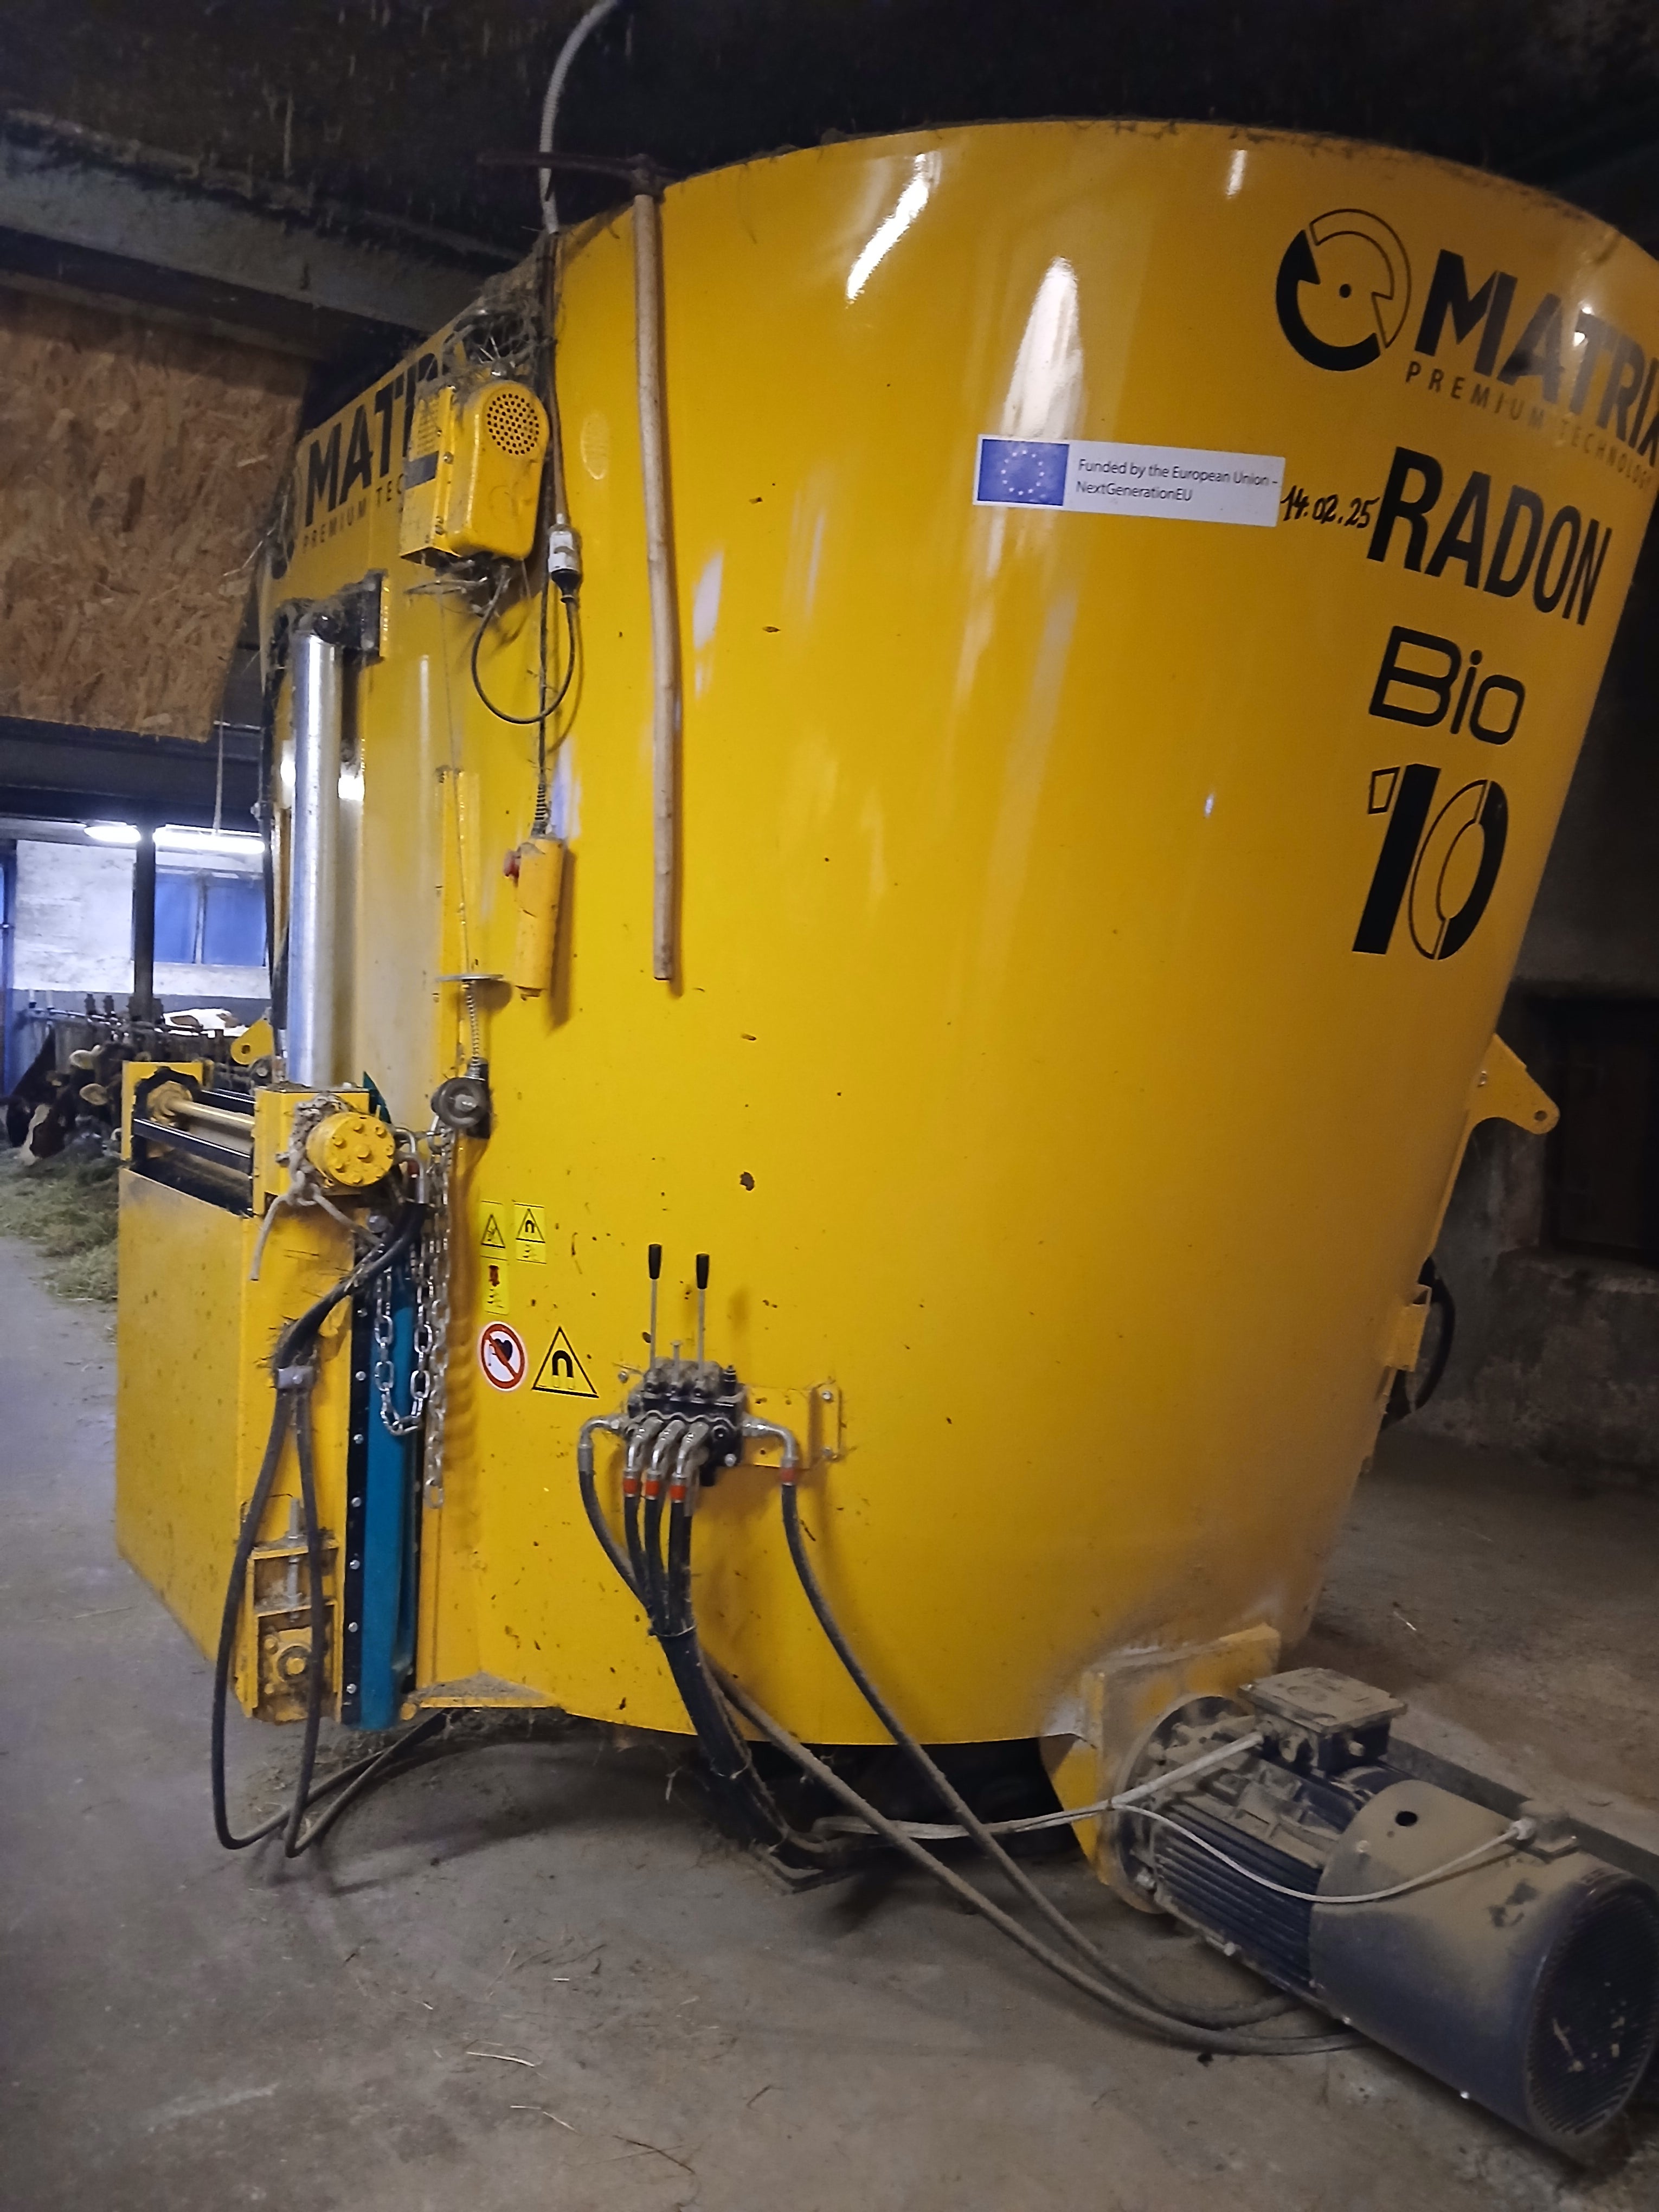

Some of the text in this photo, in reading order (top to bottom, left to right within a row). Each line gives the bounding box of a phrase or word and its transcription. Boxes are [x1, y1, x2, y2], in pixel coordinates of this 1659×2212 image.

[1405, 361, 1545, 429] PREMIUM
[1076, 480, 1193, 501] NextGenerationEU
[1078, 458, 1128, 475] Funded
[1129, 462, 1146, 479] by
[1148, 464, 1169, 478] the
[1172, 466, 1231, 484] European
[1233, 471, 1270, 486] Union
[302, 496, 366, 554] PREMIUM
[1280, 485, 1381, 529] 14.02.25
[1366, 446, 1612, 626] RADON
[1368, 625, 1526, 745] Bio
[1352, 763, 1509, 961] 10
